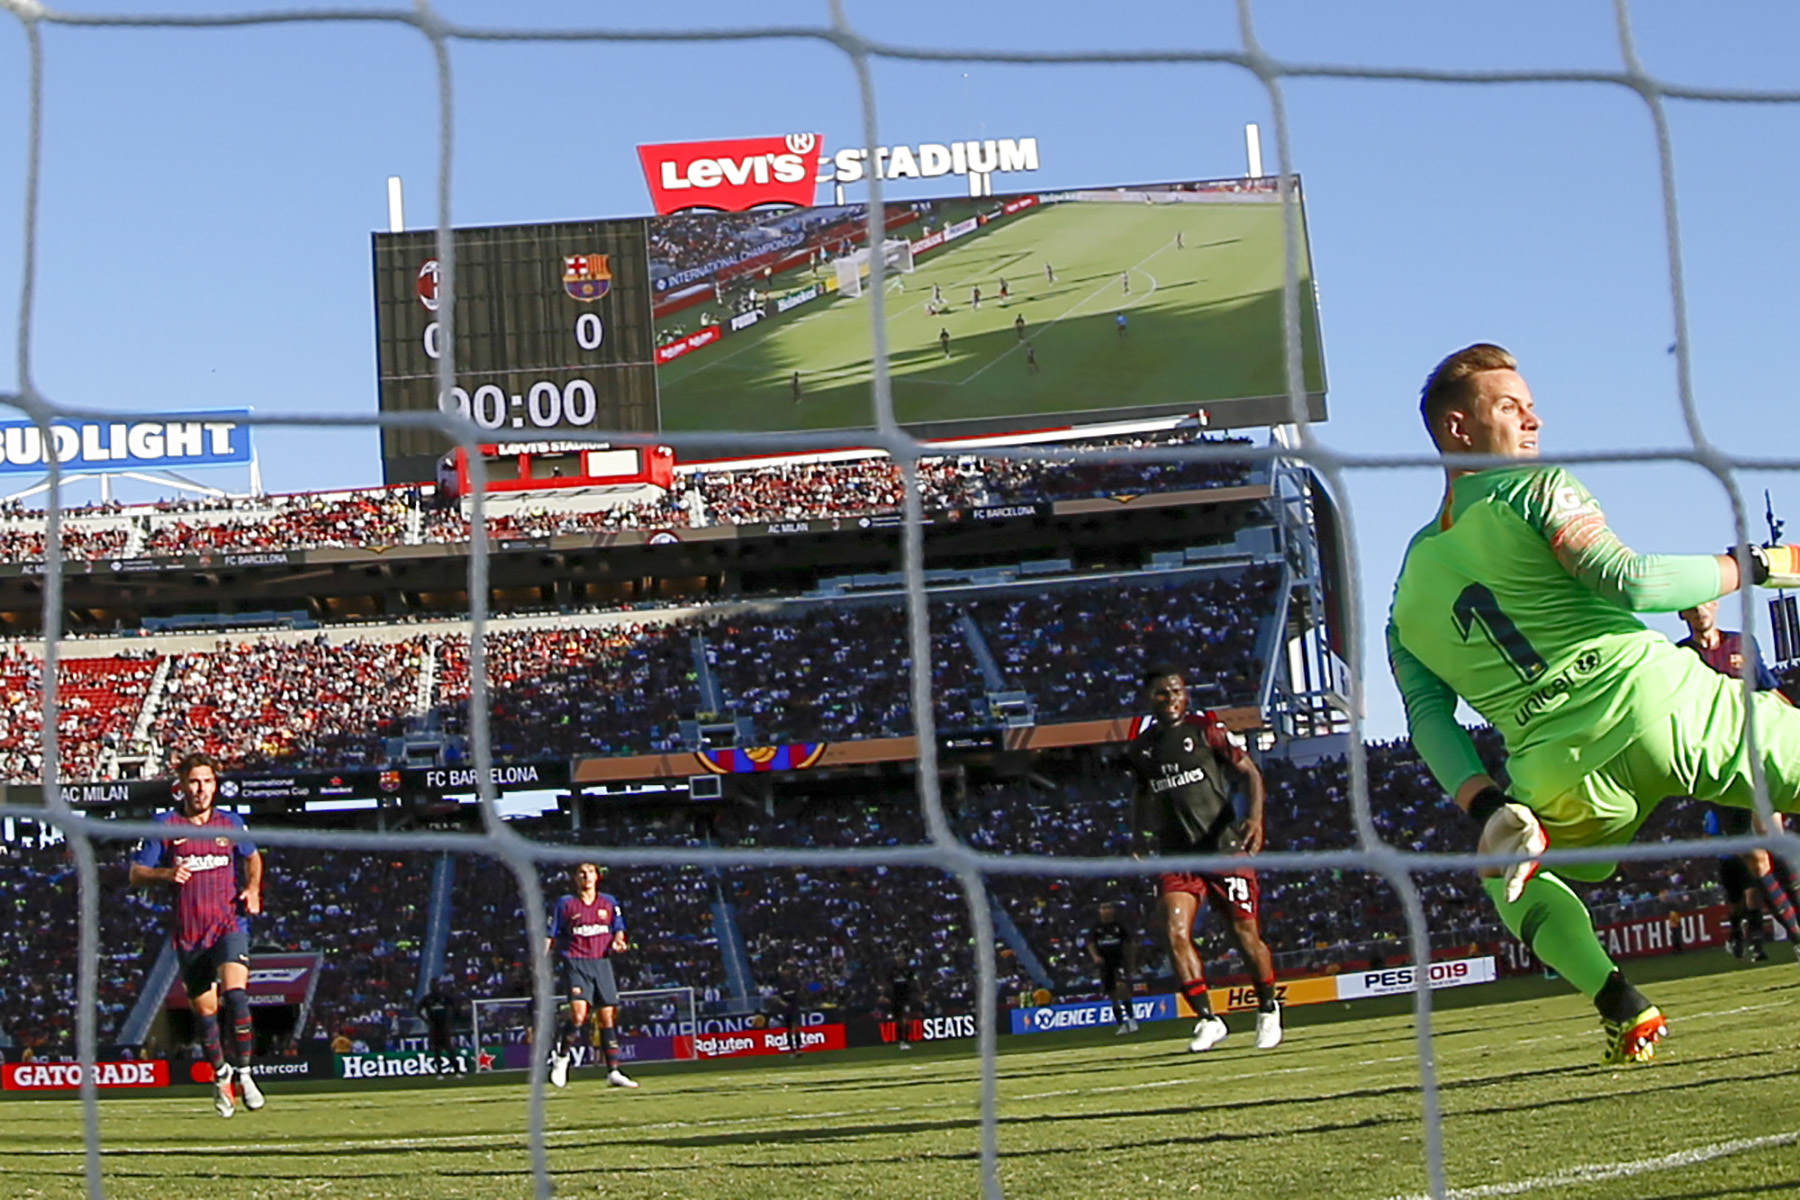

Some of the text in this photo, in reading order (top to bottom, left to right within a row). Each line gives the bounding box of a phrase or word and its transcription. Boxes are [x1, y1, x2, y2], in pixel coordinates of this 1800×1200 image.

[836, 137, 1040, 182] STADIUM
[576, 313, 603, 350] 0
[0, 425, 80, 465] UD
[238, 553, 288, 566] BARCELONA
[1452, 582, 1549, 685] 1
[241, 778, 295, 789] International
[426, 766, 539, 788] FC BARELONA
[1150, 767, 1205, 793] Emirates
[60, 785, 129, 803] AC MILAN
[241, 787, 310, 799] Champions Cup
[1224, 876, 1249, 902] 79
[1364, 970, 1413, 988] PES
[1416, 963, 1468, 983] 019
[1228, 985, 1288, 1007] Hez
[1099, 1002, 1155, 1023] ENGY
[694, 1031, 825, 1056] Rakuten Rakten
[13, 1063, 155, 1087] GATORADE
